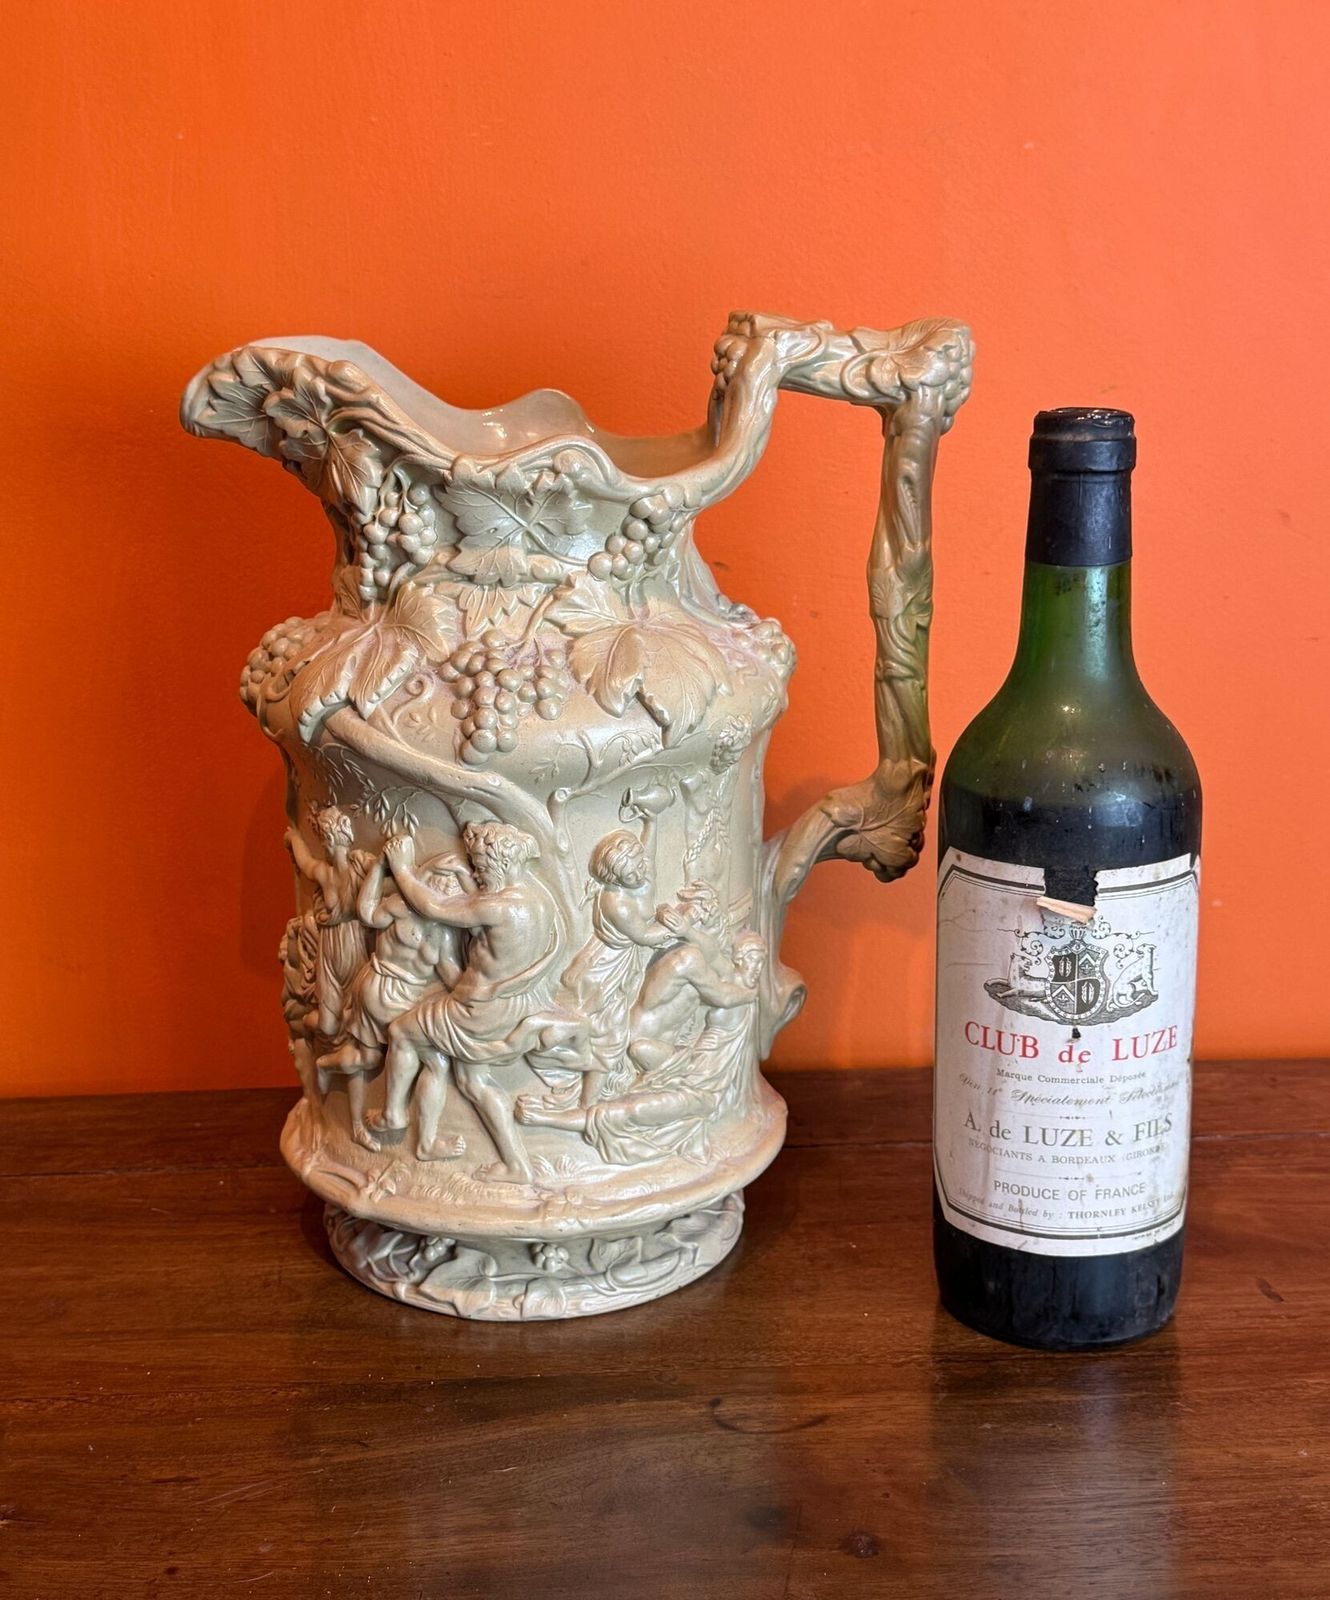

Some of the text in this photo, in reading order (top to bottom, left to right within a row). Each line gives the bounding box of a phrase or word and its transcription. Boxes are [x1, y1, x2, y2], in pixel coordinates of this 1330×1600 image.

[964, 1020, 1178, 1063] CLUB de LUZE
[996, 1067, 1033, 1082] Marque
[1037, 1074, 1104, 1085] Commerciale
[964, 1110, 1173, 1148] A. de LUZE & FILS
[1051, 1154, 1116, 1165] BORDEAUX
[993, 1180, 1146, 1201] PRODUCE OF FRANCE
[1067, 1207, 1127, 1220] THORNLEY
